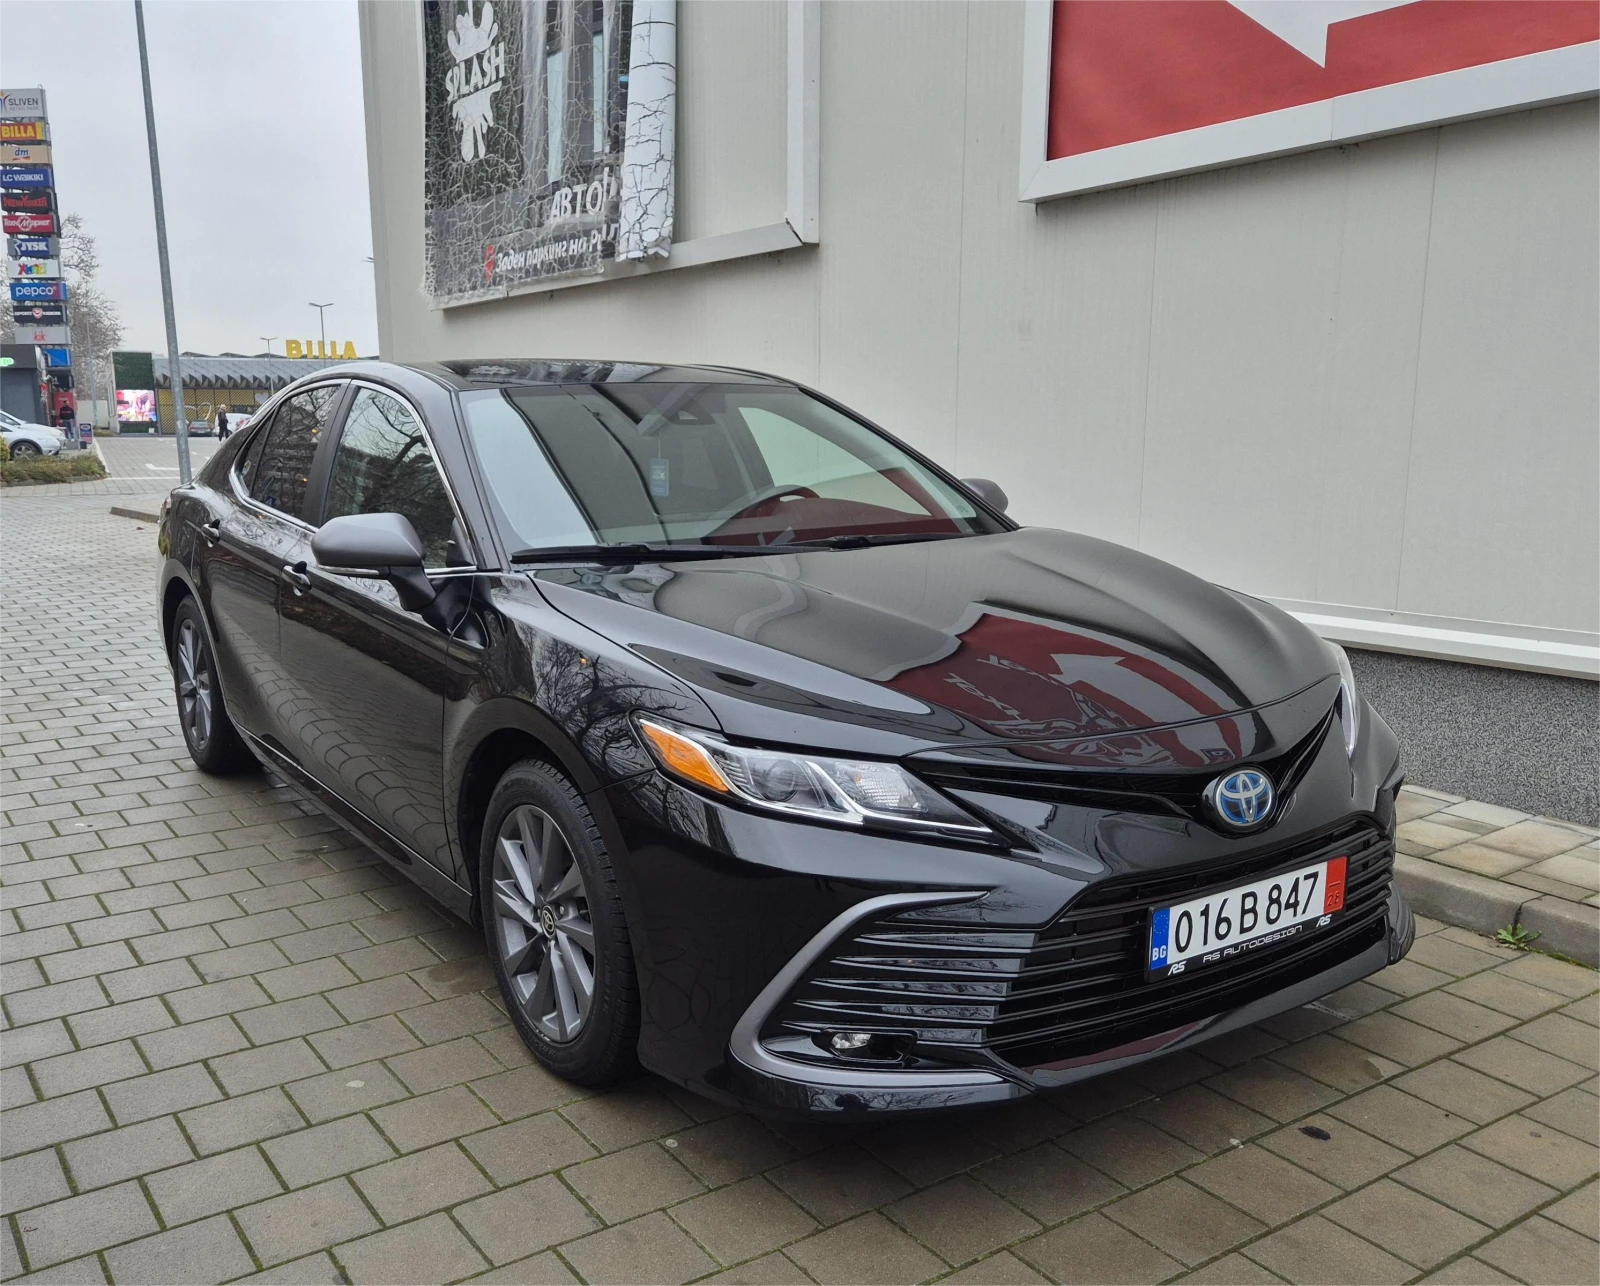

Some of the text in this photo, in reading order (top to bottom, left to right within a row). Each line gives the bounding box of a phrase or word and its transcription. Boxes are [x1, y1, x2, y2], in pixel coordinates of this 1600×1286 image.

[445, 41, 505, 104] SPLASH
[8, 97, 39, 106] SLIVEN
[1, 125, 36, 138] BILLA
[14, 147, 29, 156] dm
[20, 241, 49, 251] JYSK
[15, 286, 54, 297] pepco
[285, 339, 358, 359] BILLA
[1152, 945, 1167, 961] BG
